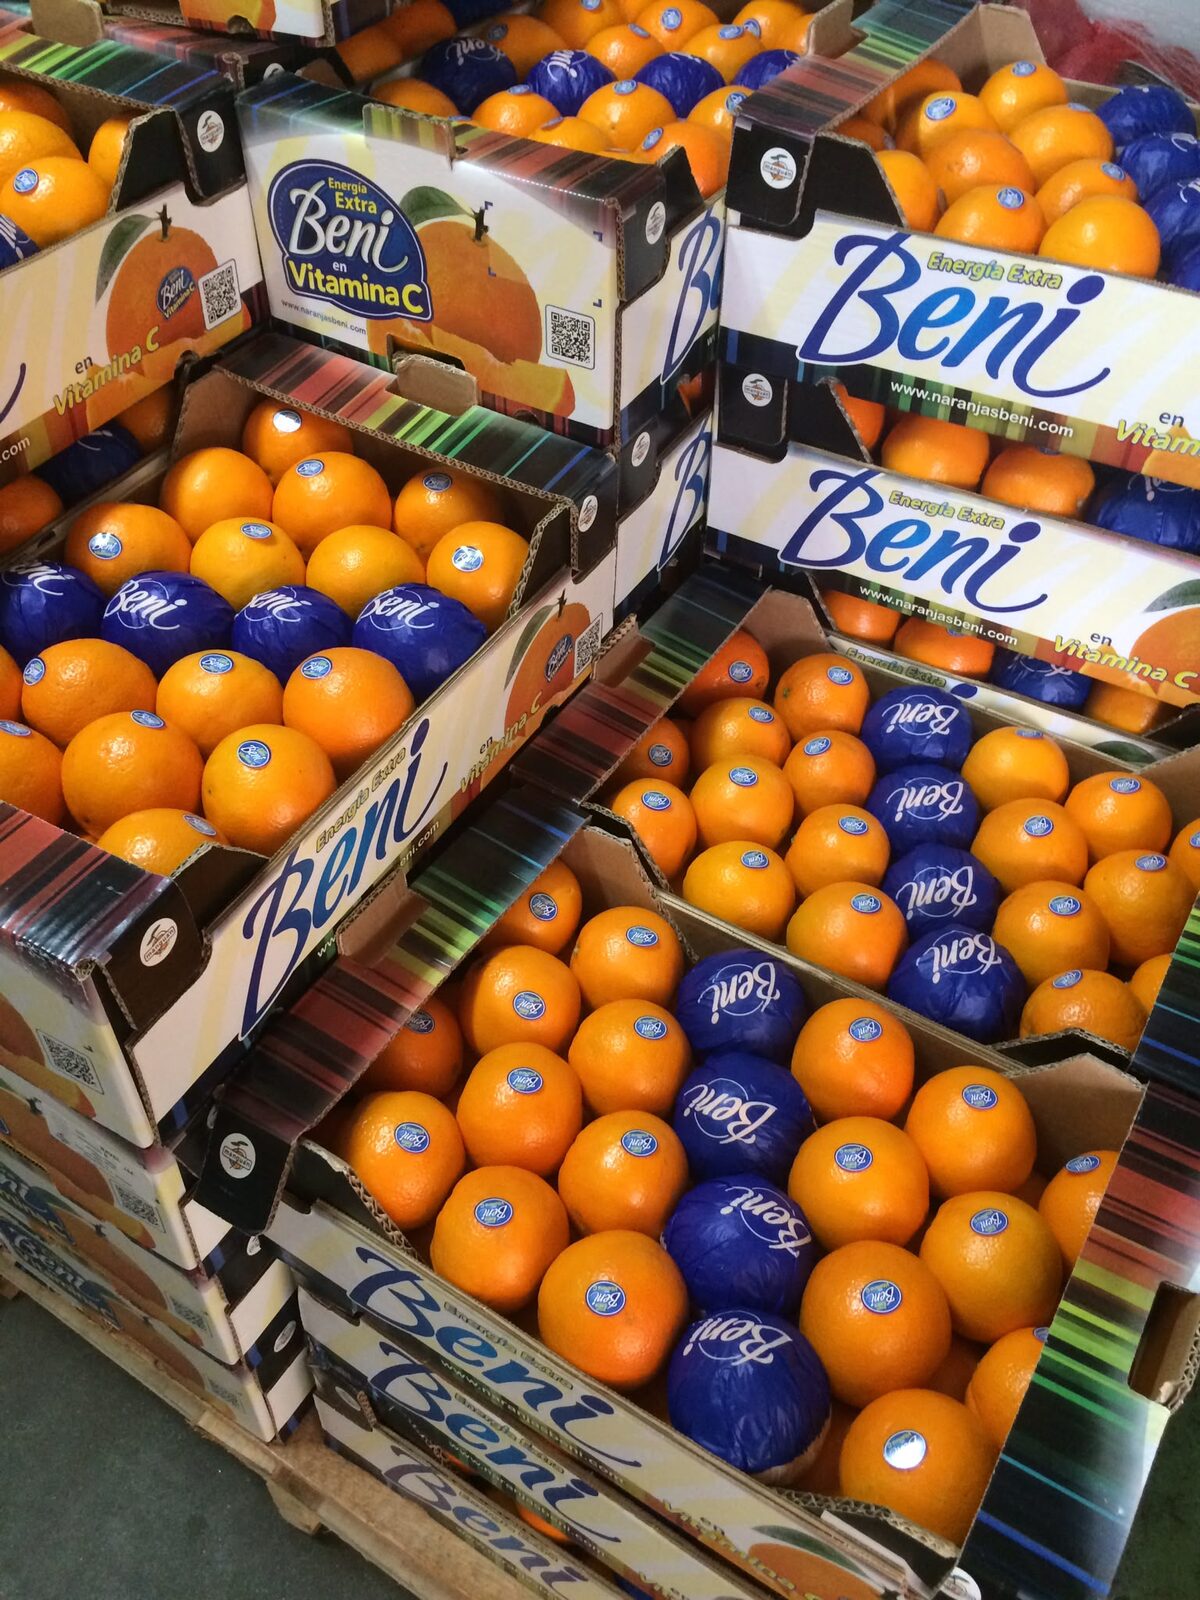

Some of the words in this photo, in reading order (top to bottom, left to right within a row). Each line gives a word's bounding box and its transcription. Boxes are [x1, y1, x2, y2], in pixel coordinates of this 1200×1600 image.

[335, 191, 377, 214] Extra
[288, 180, 409, 273] Beni
[332, 261, 348, 273] en
[1007, 263, 1063, 289] Extra
[288, 260, 400, 307] Vitamina
[402, 283, 424, 314] C
[281, 300, 367, 335] www.naranjasbeni.com
[800, 234, 1110, 398] Beni
[53, 344, 142, 416] Vitamina
[145, 326, 160, 352] C
[75, 356, 93, 375] en
[890, 381, 1074, 438] www.naranjasbeni.com
[1159, 412, 1184, 428] en
[957, 507, 1005, 529] Extra
[780, 468, 1048, 612] Beni
[104, 580, 187, 630] Beni
[356, 588, 439, 629] Beni
[859, 585, 1019, 646] www.naranjasbeni.com
[1089, 631, 1112, 647] en
[905, 666, 947, 687] Extra
[1053, 636, 1169, 682] Vitamina
[1173, 671, 1198, 688] C
[882, 702, 959, 739] Beni
[460, 713, 527, 793] Vitamina
[531, 691, 542, 715] C
[479, 736, 493, 754] en
[371, 748, 407, 793] Extra
[886, 781, 964, 822] Beni
[241, 718, 448, 1039] Beni
[896, 866, 977, 920] Beni
[632, 932, 655, 942] Beni
[917, 933, 1002, 985] Beni
[520, 1000, 542, 1015] Beni
[698, 962, 780, 1024] Beni
[640, 1023, 662, 1033] Beni
[857, 1022, 876, 1036] Beni
[512, 1075, 538, 1089] Beni
[970, 1090, 992, 1102] Beni
[683, 1084, 778, 1145] Beni
[401, 1130, 426, 1147] Beni
[627, 1136, 652, 1149] Beni
[843, 1151, 866, 1165] Beni
[482, 1204, 507, 1222] Beni
[720, 1186, 812, 1258] Beni
[980, 1213, 1001, 1230] Beni
[593, 1291, 620, 1310] Beni
[870, 1287, 894, 1307] Beni
[350, 1247, 642, 1467] Beni
[683, 1317, 792, 1366] Beni
[370, 1342, 622, 1543] Beni
[383, 1445, 589, 1600] Beni
